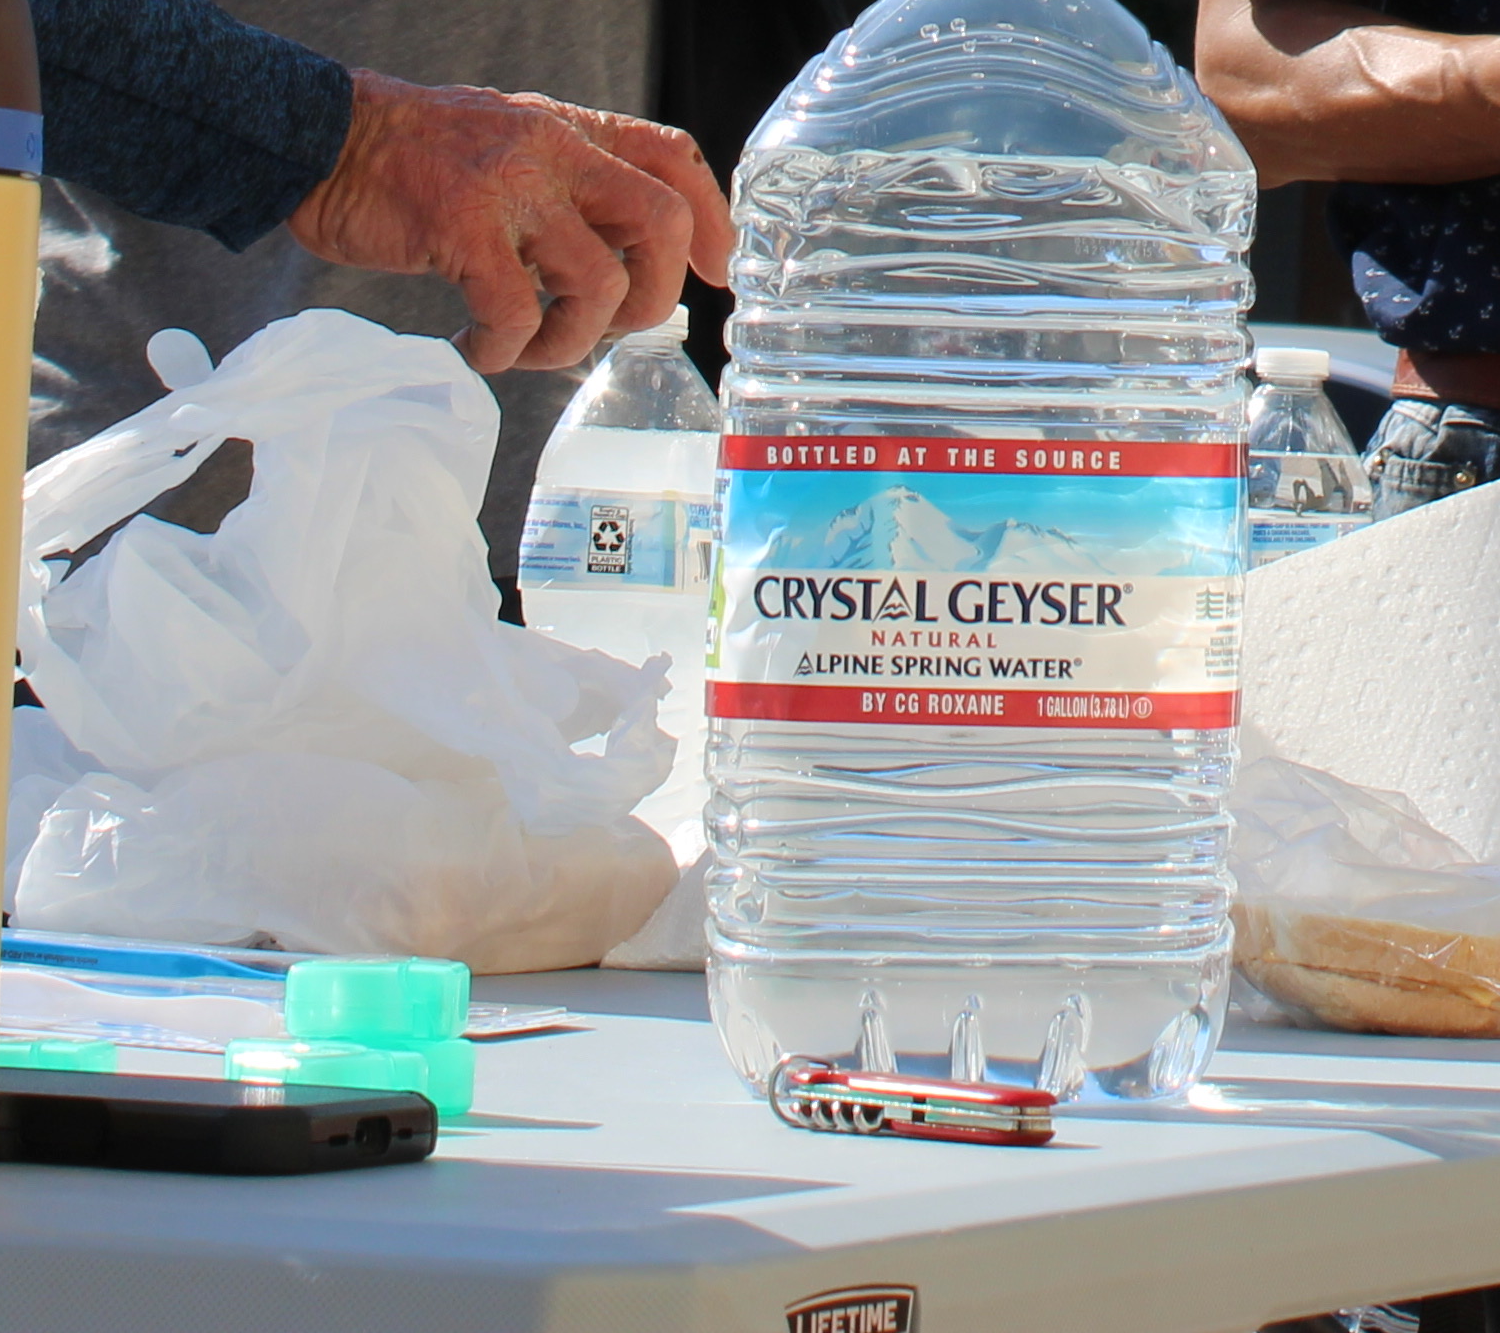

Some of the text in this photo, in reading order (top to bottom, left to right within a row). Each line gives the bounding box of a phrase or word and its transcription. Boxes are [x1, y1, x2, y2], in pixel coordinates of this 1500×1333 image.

[766, 445, 1121, 470] BOTTLED AT THE SOURCE
[591, 555, 623, 564] PLASTIC
[591, 564, 622, 573] BOTTLE
[753, 575, 939, 624] CRYSTAL
[871, 630, 997, 649] NATURAL
[792, 650, 884, 678] ALPINE
[891, 654, 982, 678] SPRING
[862, 691, 1005, 716] BY CG ROXANE
[1037, 696, 1045, 717] 1
[1047, 696, 1088, 718] GALLON
[1090, 694, 1117, 719] (3.78
[1118, 694, 1130, 720] L)
